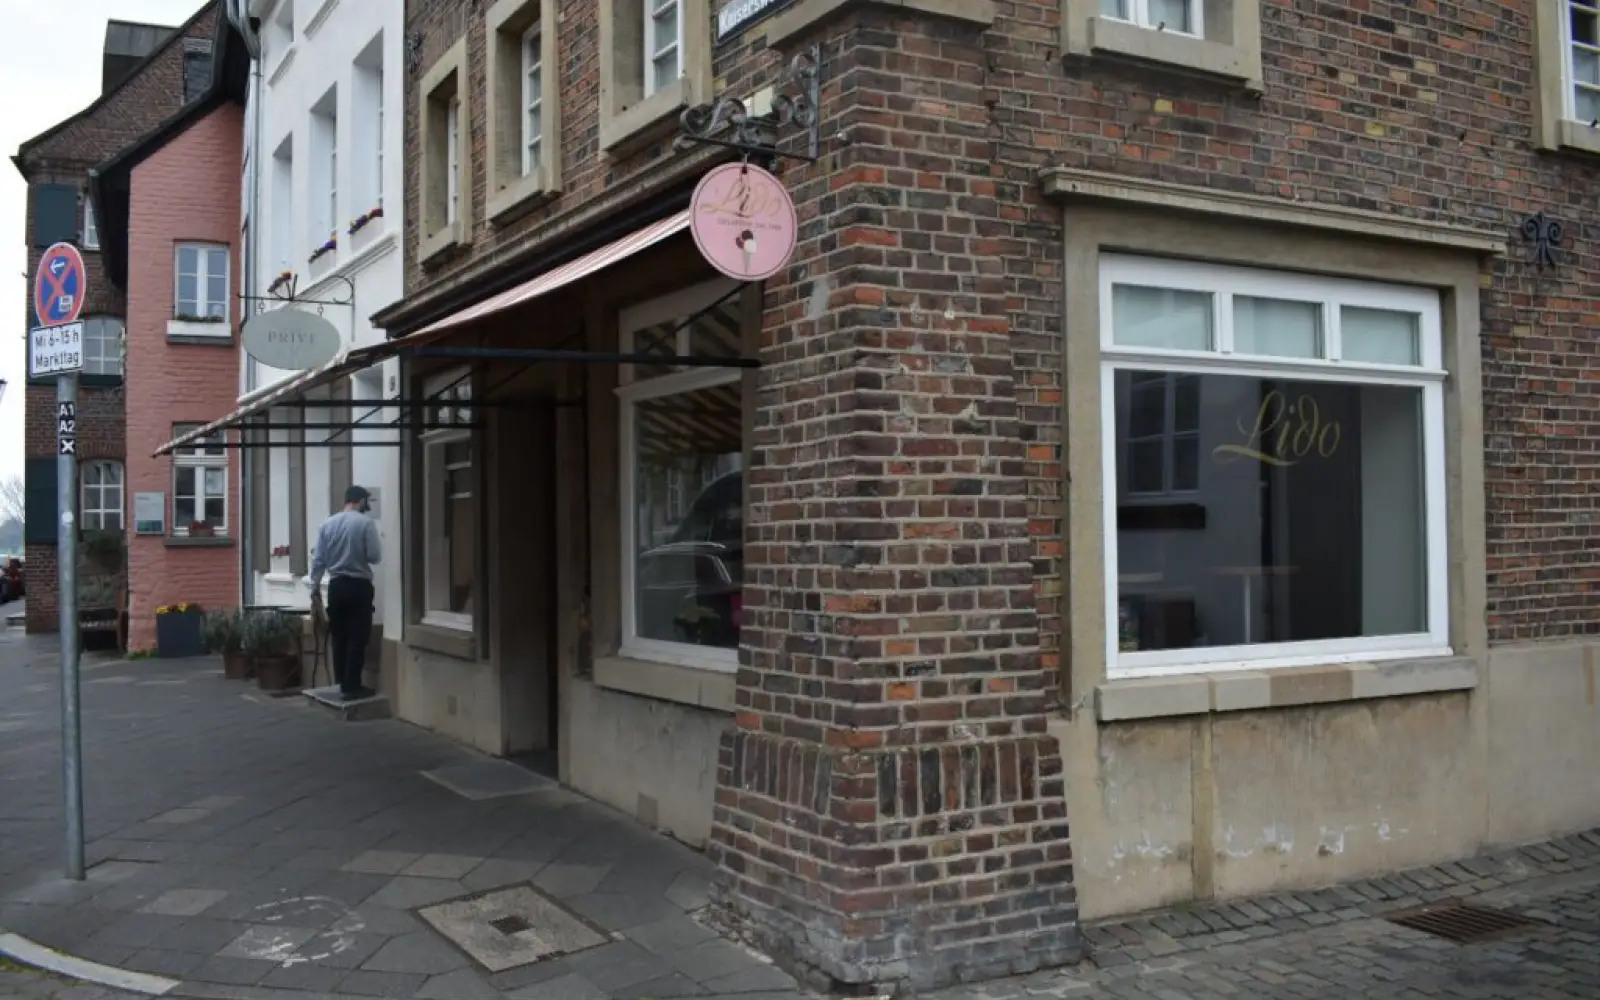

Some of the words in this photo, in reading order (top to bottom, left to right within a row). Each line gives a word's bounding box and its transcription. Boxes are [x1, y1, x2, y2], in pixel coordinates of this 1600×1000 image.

[699, 177, 782, 219] Lido
[35, 335, 47, 347] Mi
[73, 329, 79, 342] h
[35, 351, 79, 369] Markttag
[60, 403, 75, 416] A1
[60, 420, 75, 432] A2
[1212, 389, 1340, 466] Lido
